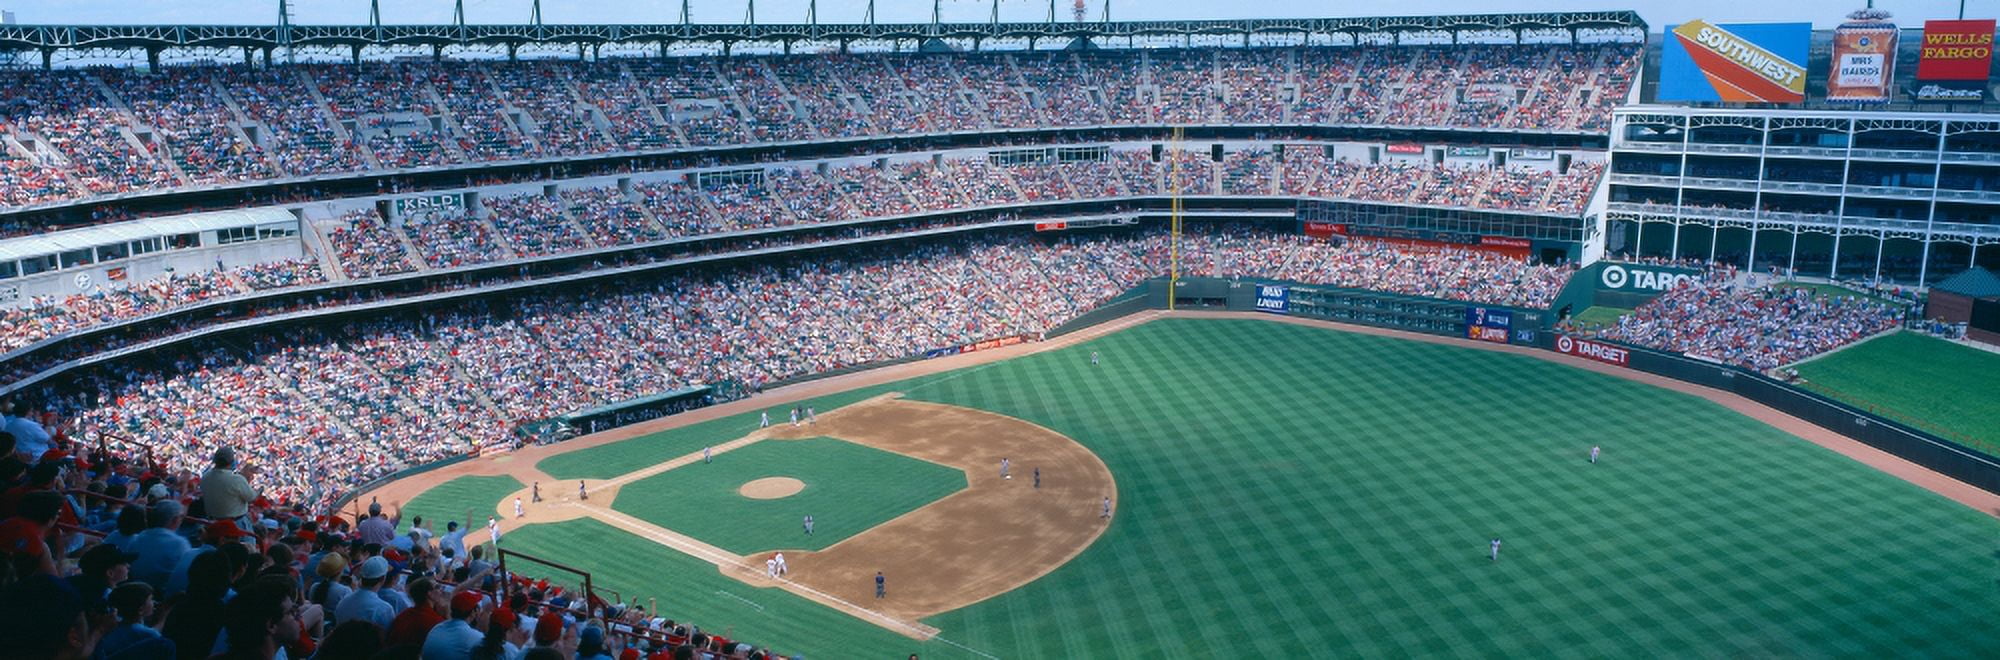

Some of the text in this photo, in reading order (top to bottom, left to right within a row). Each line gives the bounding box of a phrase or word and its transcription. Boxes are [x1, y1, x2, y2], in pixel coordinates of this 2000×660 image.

[1925, 33, 1992, 45] WELLS
[1697, 27, 1800, 85] SOUTHWEST
[1923, 47, 1989, 59] FARGO
[404, 195, 453, 210] KRLD
[1576, 340, 1628, 362] TARGET
